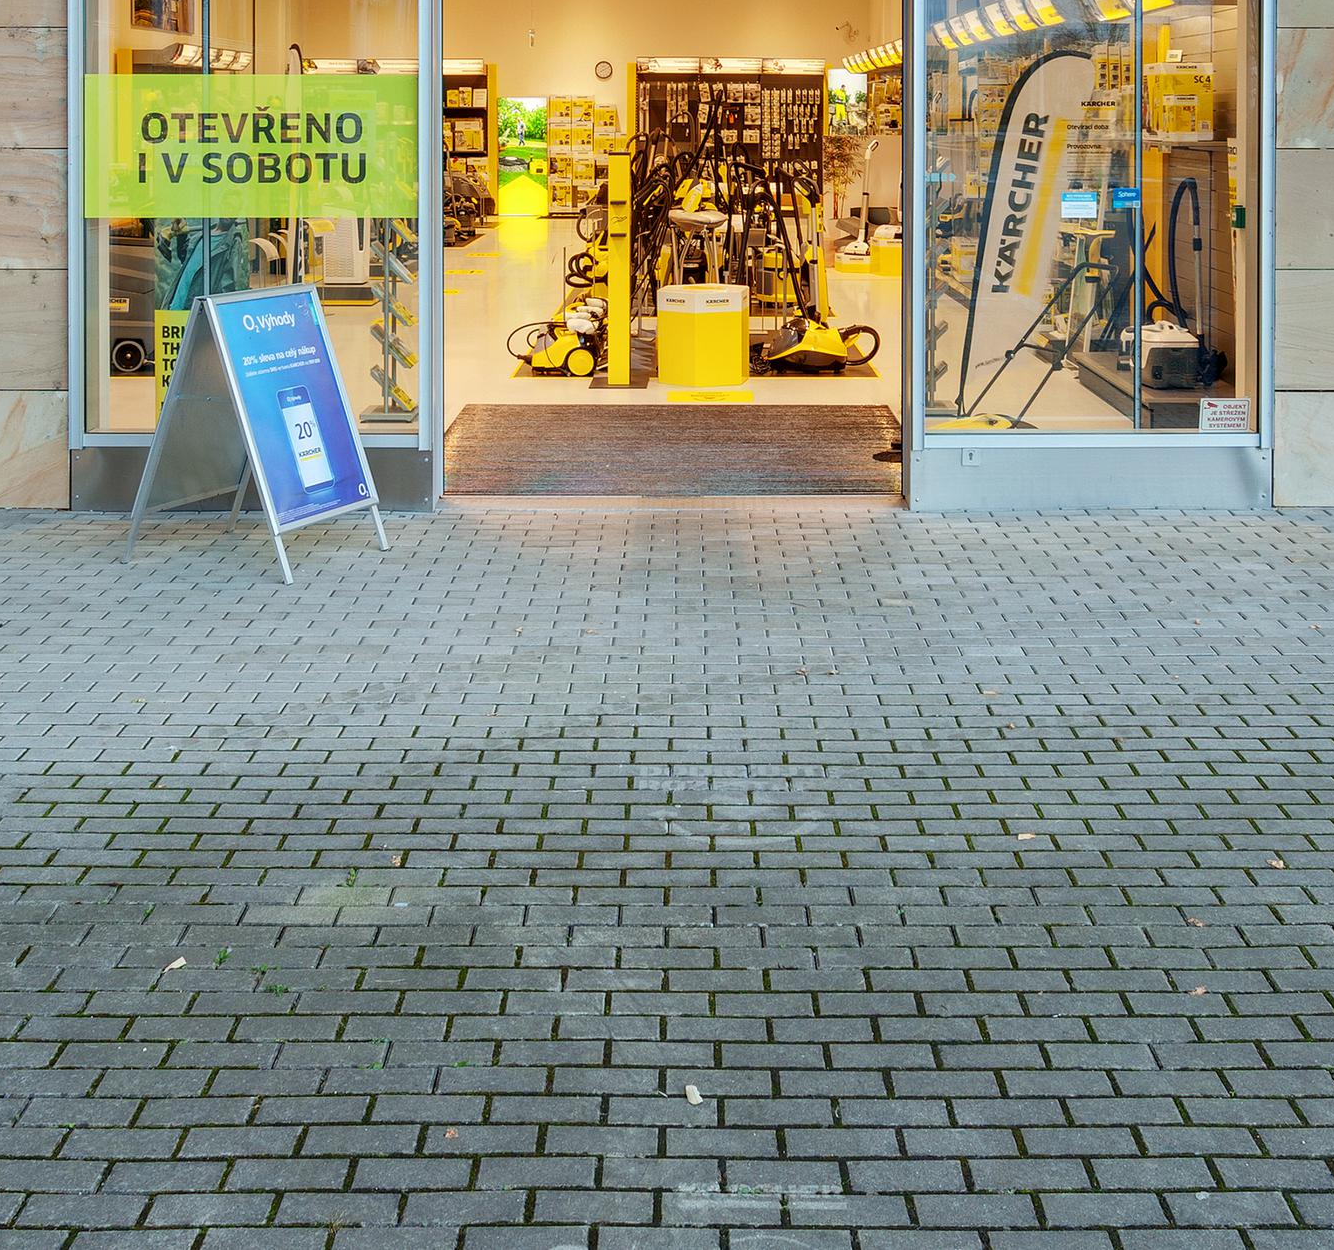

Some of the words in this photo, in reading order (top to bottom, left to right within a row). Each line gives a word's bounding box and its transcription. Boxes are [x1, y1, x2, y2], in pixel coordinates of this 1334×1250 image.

[141, 106, 364, 144] OTEVŘENO
[138, 152, 146, 184] I
[161, 152, 189, 184] V
[202, 152, 366, 184] SOBOTU
[991, 112, 1050, 294] KÄRCHER
[257, 311, 296, 332] Výhody
[276, 351, 285, 360] na
